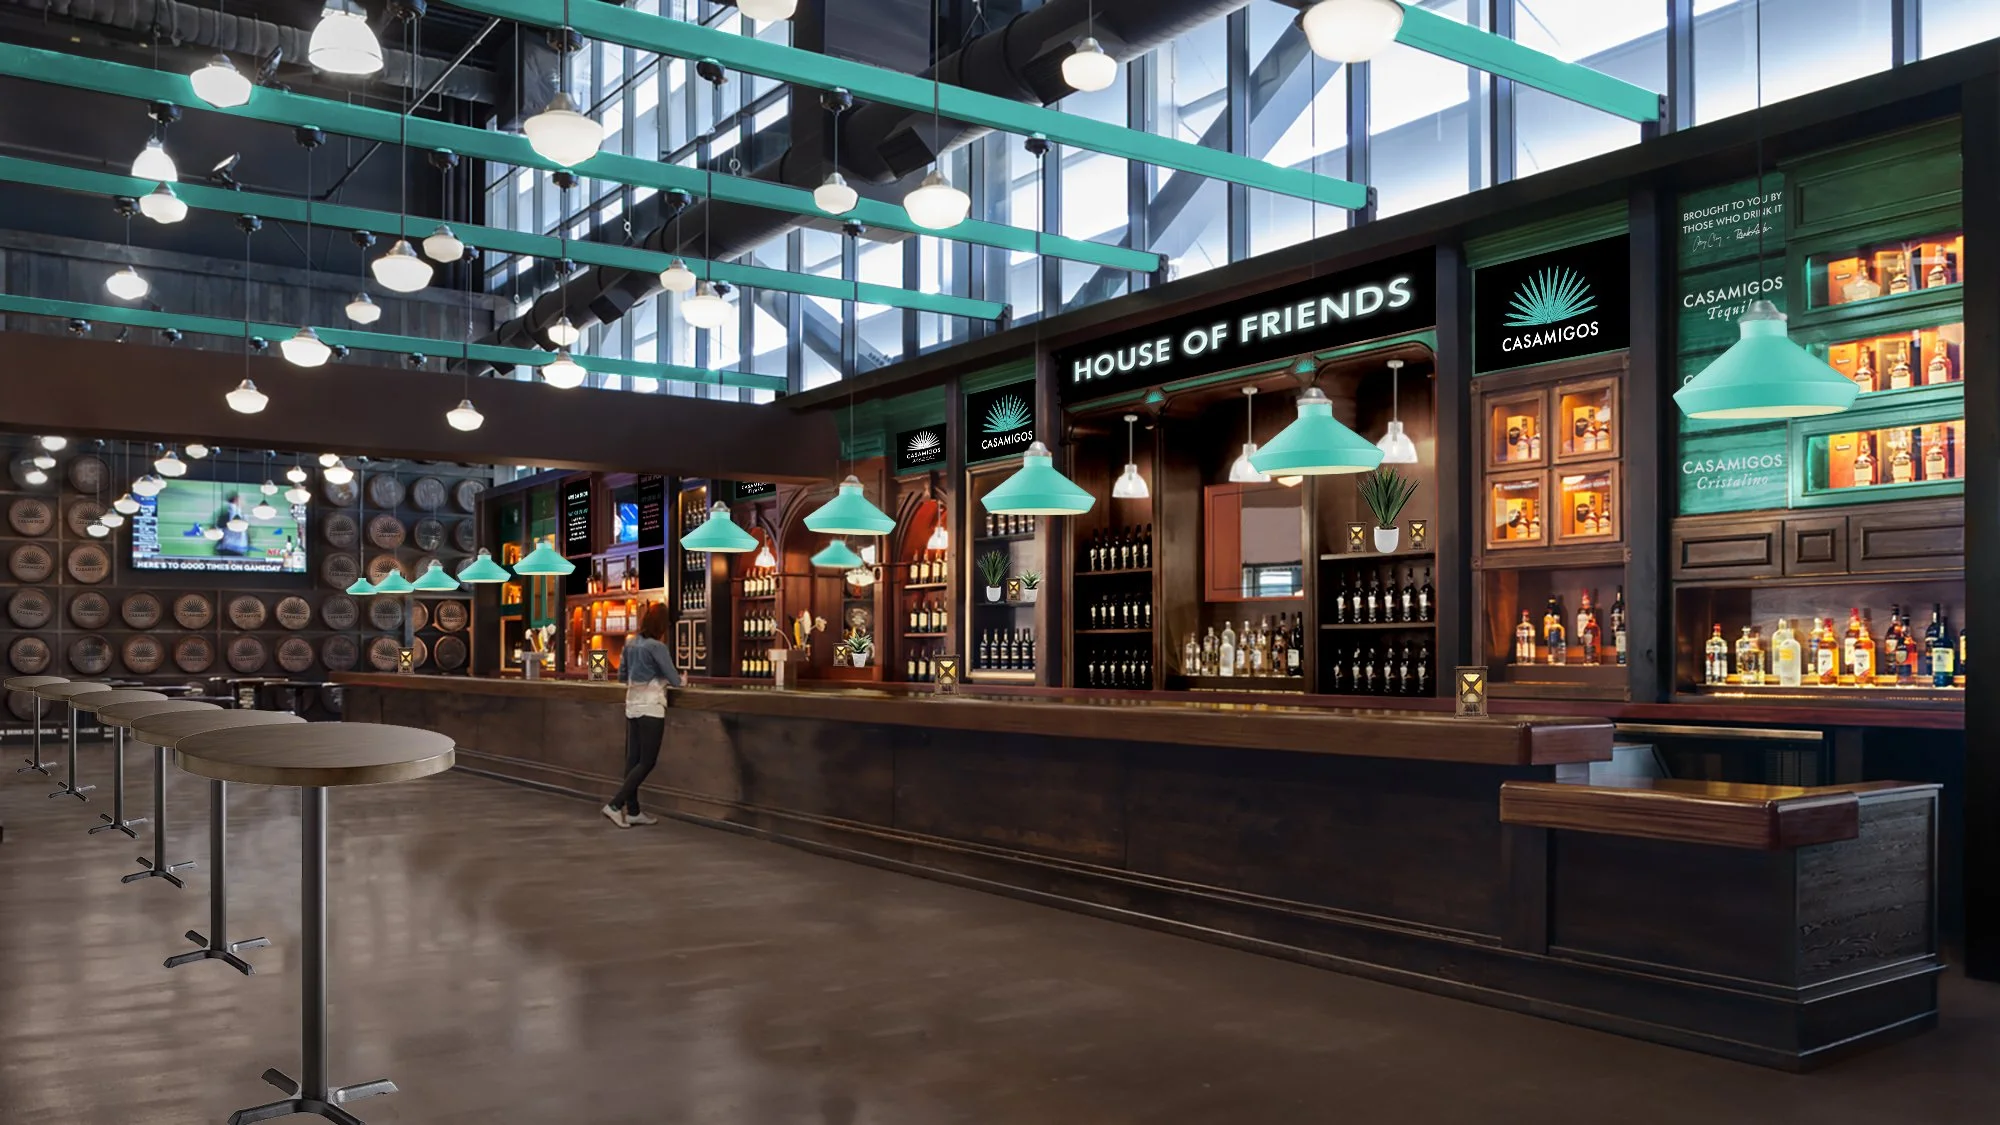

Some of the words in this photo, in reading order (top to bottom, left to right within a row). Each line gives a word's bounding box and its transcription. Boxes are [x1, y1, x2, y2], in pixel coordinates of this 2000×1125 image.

[1683, 203, 1730, 222] BROUGHT
[1732, 200, 1745, 210] TO
[1747, 194, 1768, 207] YOU
[1770, 191, 1782, 202] BY
[1683, 219, 1714, 234] THOSE
[1716, 214, 1741, 226] WHO
[1743, 206, 1772, 221] DRINK
[1774, 204, 1782, 214] IT
[1683, 276, 1783, 308] CASAMIGOS
[1073, 337, 1171, 383] HOUSE
[1182, 323, 1228, 356] OF
[1241, 276, 1412, 343] FRIENDS
[1502, 320, 1599, 352] CASAMIGOS
[981, 430, 1033, 450] CASAMIGOS
[1682, 454, 1783, 474] CASAMIGOS
[1697, 473, 1769, 490] Cristalino
[180, 562, 205, 570] GOOD
[206, 563, 229, 571] TIMES
[231, 563, 243, 571] ON
[244, 564, 281, 572] GAMEDAY
